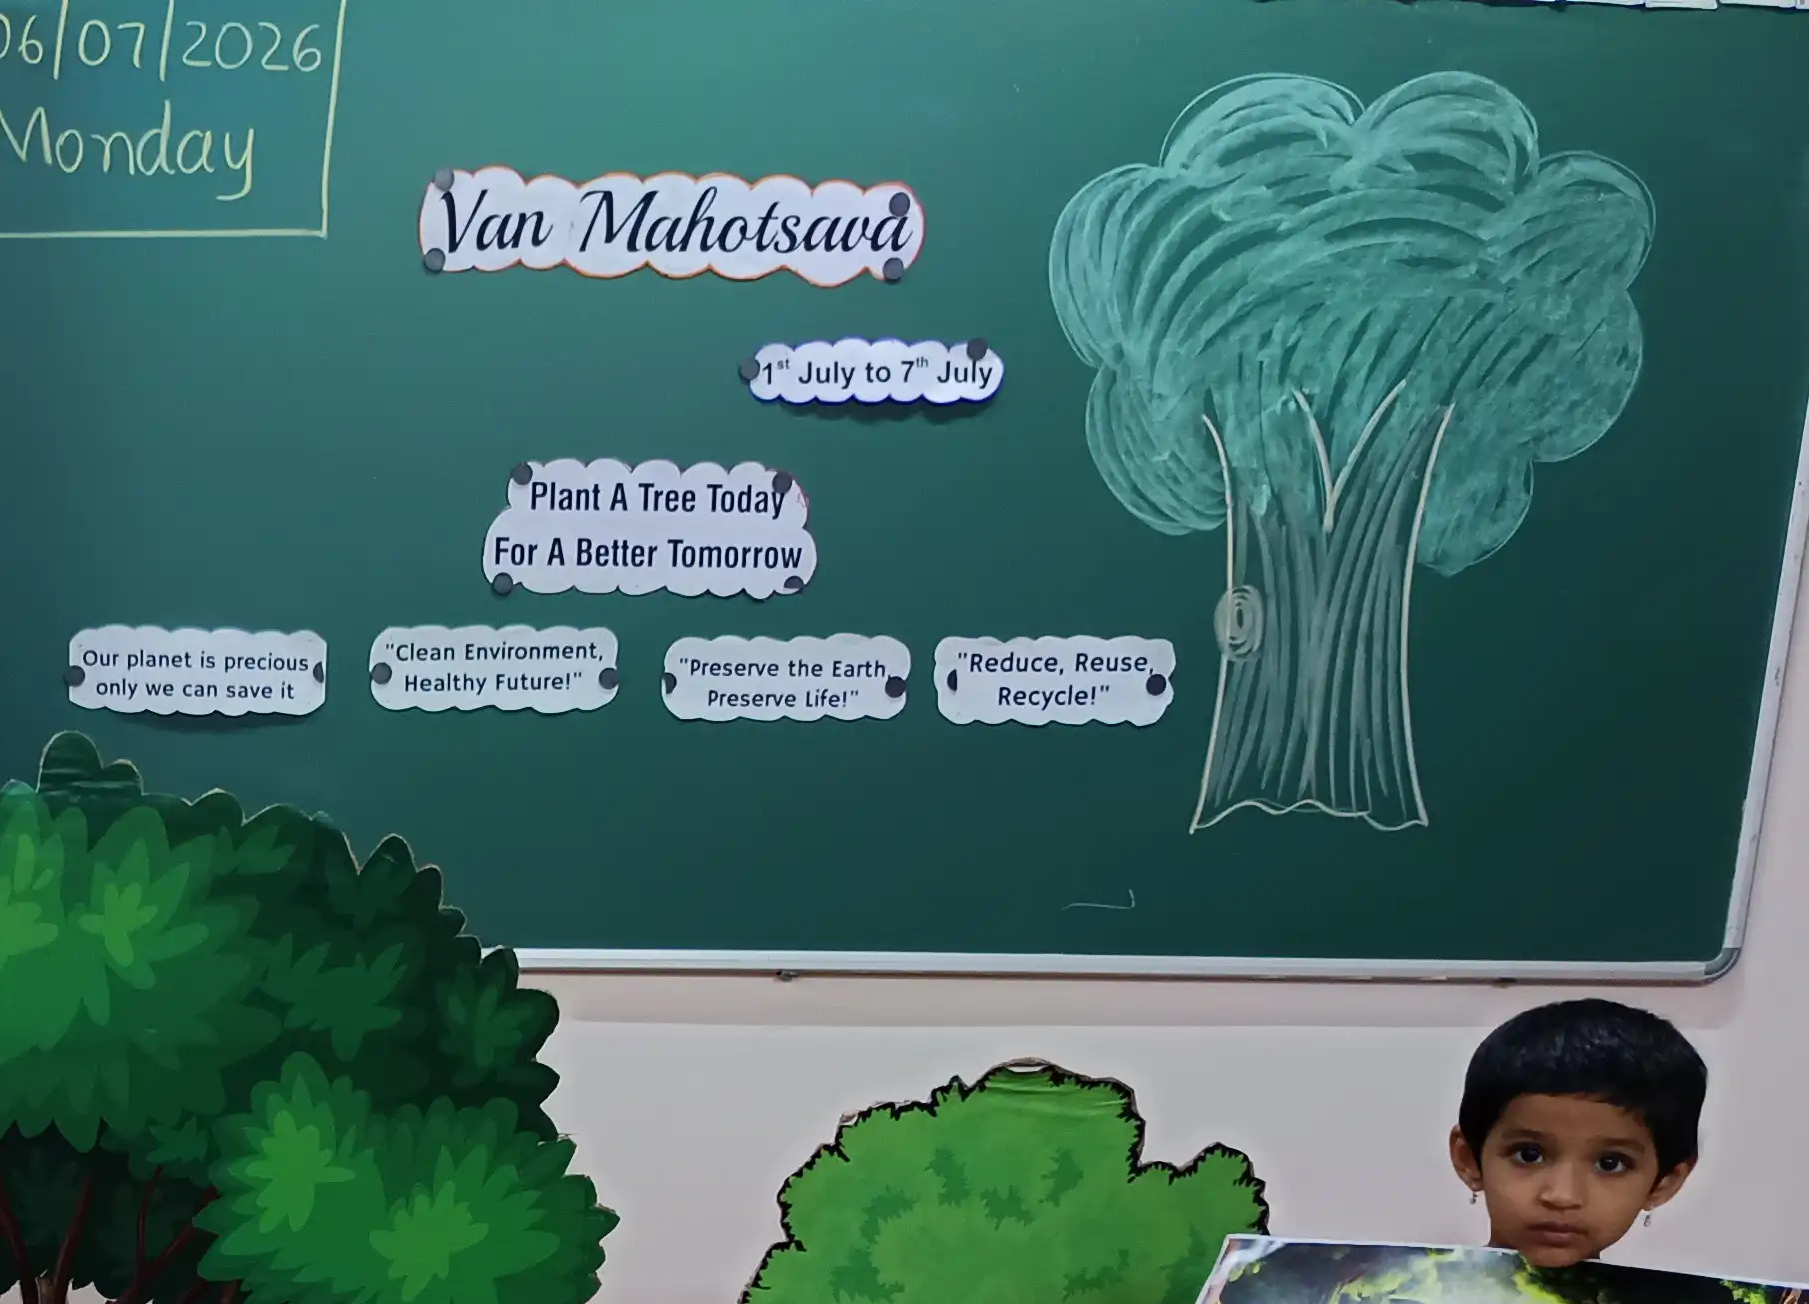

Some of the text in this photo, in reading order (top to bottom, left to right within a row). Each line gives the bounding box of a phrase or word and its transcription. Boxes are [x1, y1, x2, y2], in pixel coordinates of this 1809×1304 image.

[441, 186, 916, 255] Van Mahotsava
[761, 356, 994, 391] 1st July to 7th July
[530, 481, 786, 518] Plant A Tree Today
[494, 536, 803, 570] For A Better Tomorrow
[82, 649, 309, 679] Our planet is precious
[385, 641, 605, 664] "Clean Environment,
[958, 652, 1155, 677] "Reduce, Reuse,
[679, 658, 892, 681] "Preserve the Earth,
[96, 677, 295, 701] only we can save it
[404, 671, 583, 697] Healthy Future!"
[998, 684, 1110, 709] Recycle!"
[707, 689, 859, 709] Preserve Life!"
